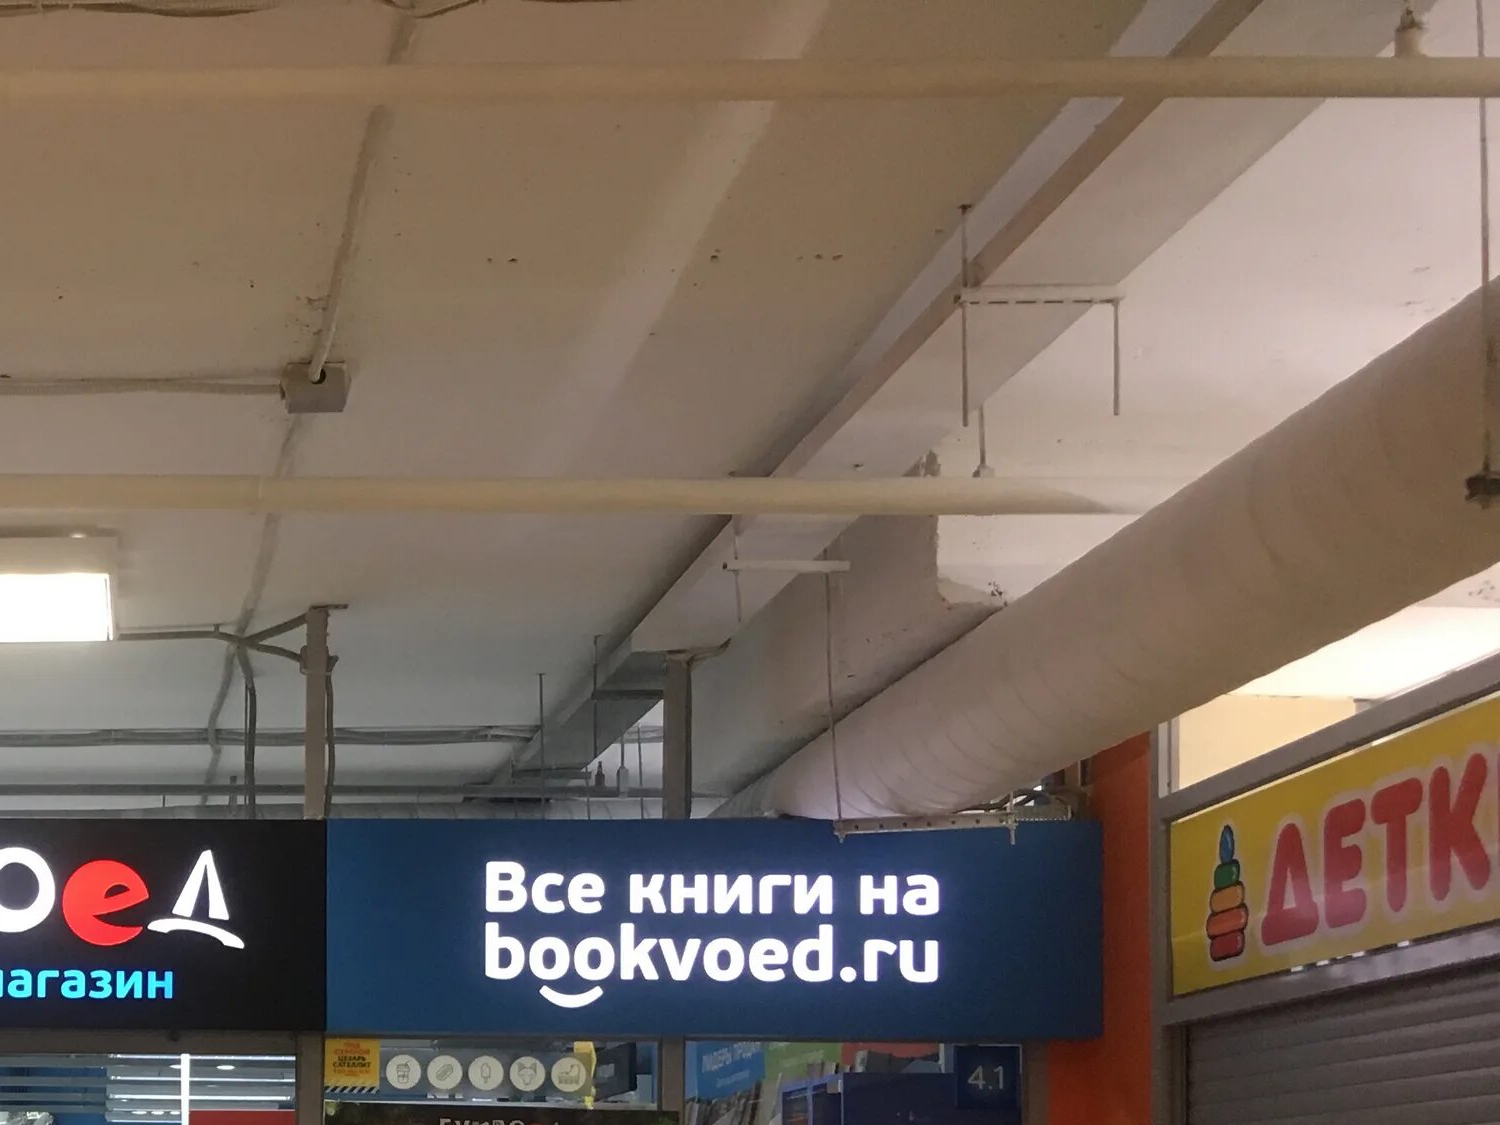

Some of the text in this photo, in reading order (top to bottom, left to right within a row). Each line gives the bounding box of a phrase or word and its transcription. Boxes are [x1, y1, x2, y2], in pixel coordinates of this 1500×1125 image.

[1260, 753, 1500, 946] ДЕТК
[484, 860, 941, 917] Все книги на
[484, 921, 940, 985] bookvoed.ru
[967, 1064, 1005, 1090] 4.1
